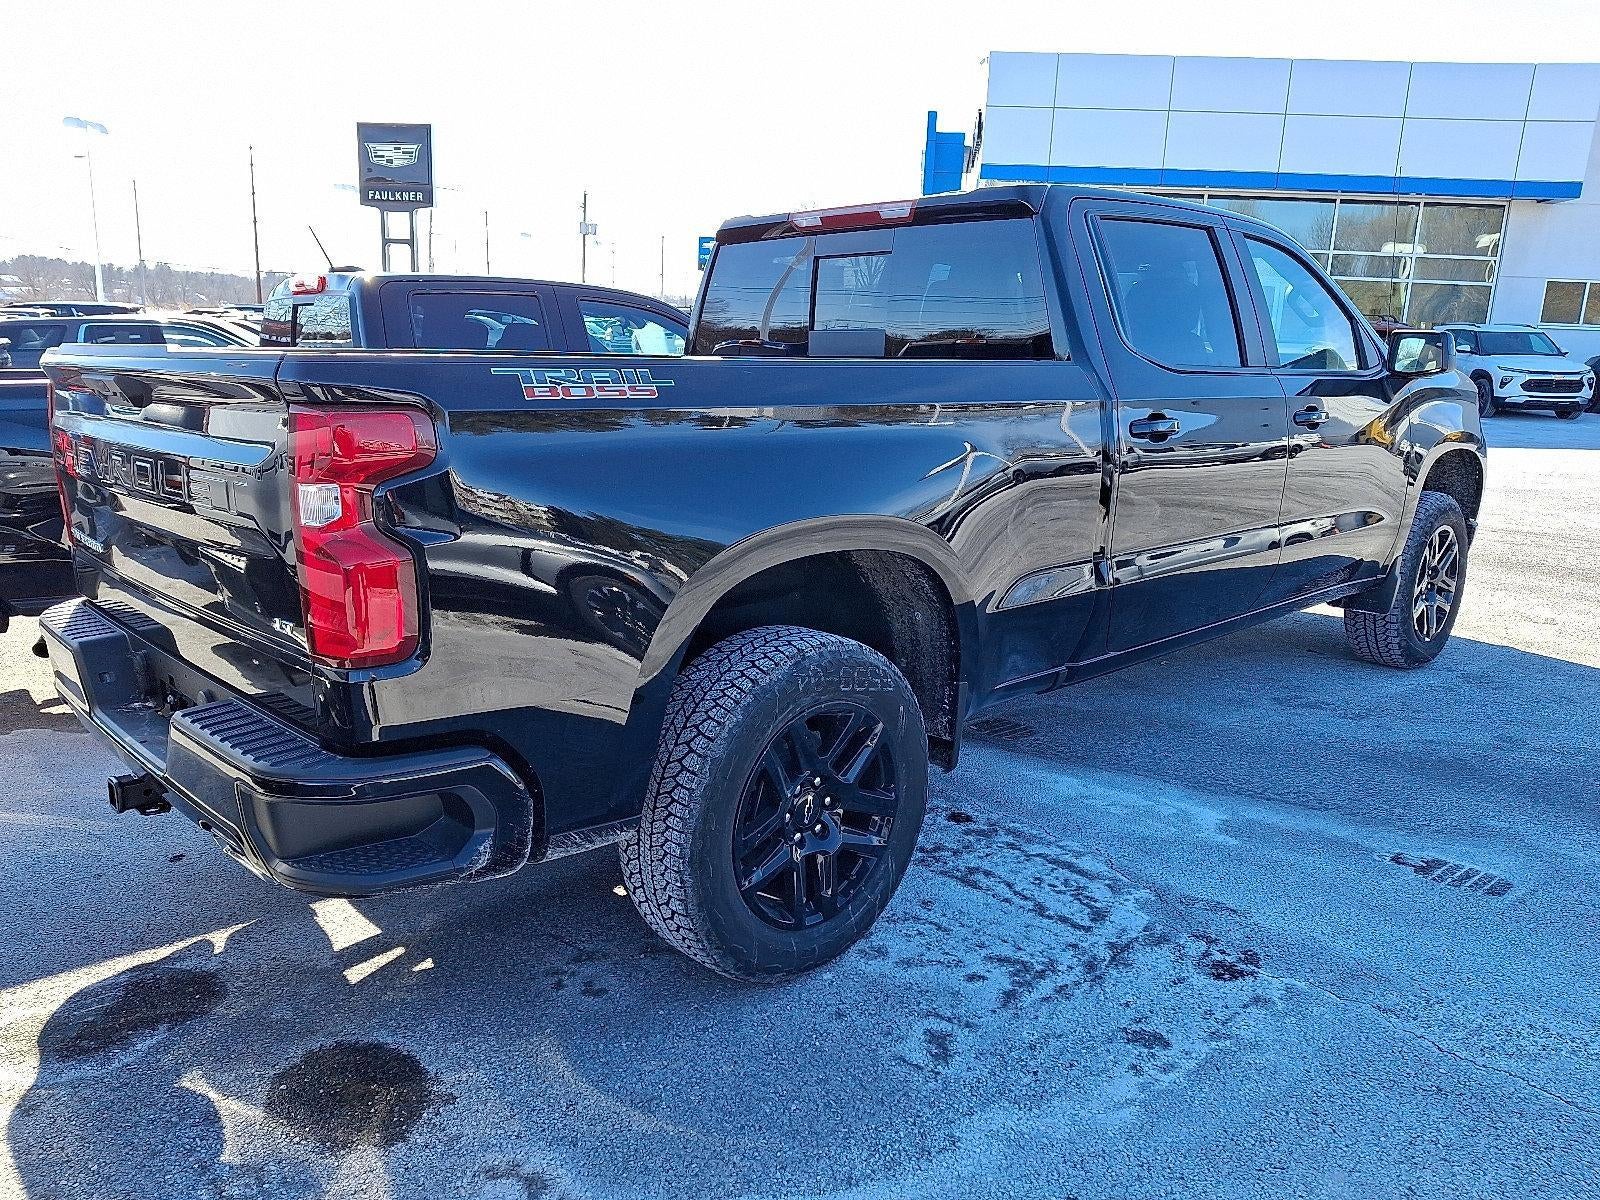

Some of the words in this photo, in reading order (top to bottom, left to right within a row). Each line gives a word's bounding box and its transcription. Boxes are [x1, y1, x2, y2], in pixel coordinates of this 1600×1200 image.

[368, 190, 423, 201] FAULKNER
[490, 367, 675, 386] TRAIL
[522, 385, 659, 400] BOSS
